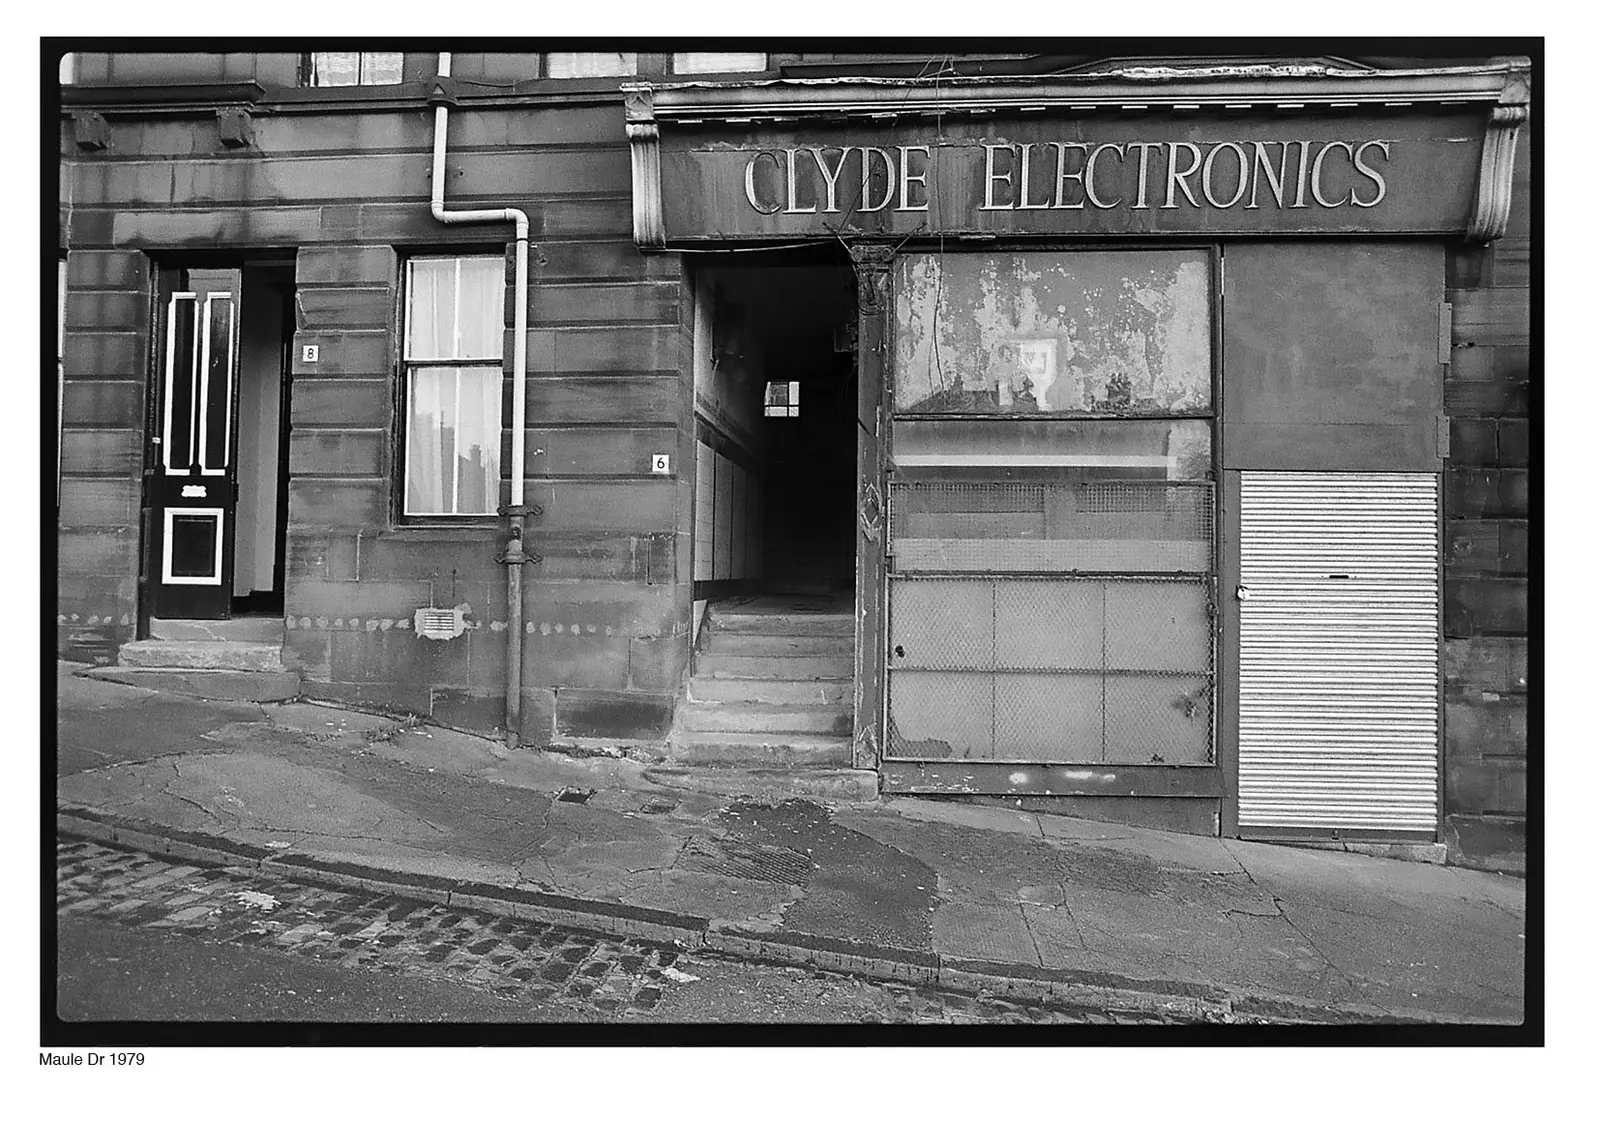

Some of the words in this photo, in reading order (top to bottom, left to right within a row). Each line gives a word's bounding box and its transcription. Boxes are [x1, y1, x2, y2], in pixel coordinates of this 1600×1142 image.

[744, 145, 931, 215] CLYDE
[979, 140, 1390, 212] ELECTRONICS
[307, 348, 314, 359] 8
[657, 457, 665, 469] 6
